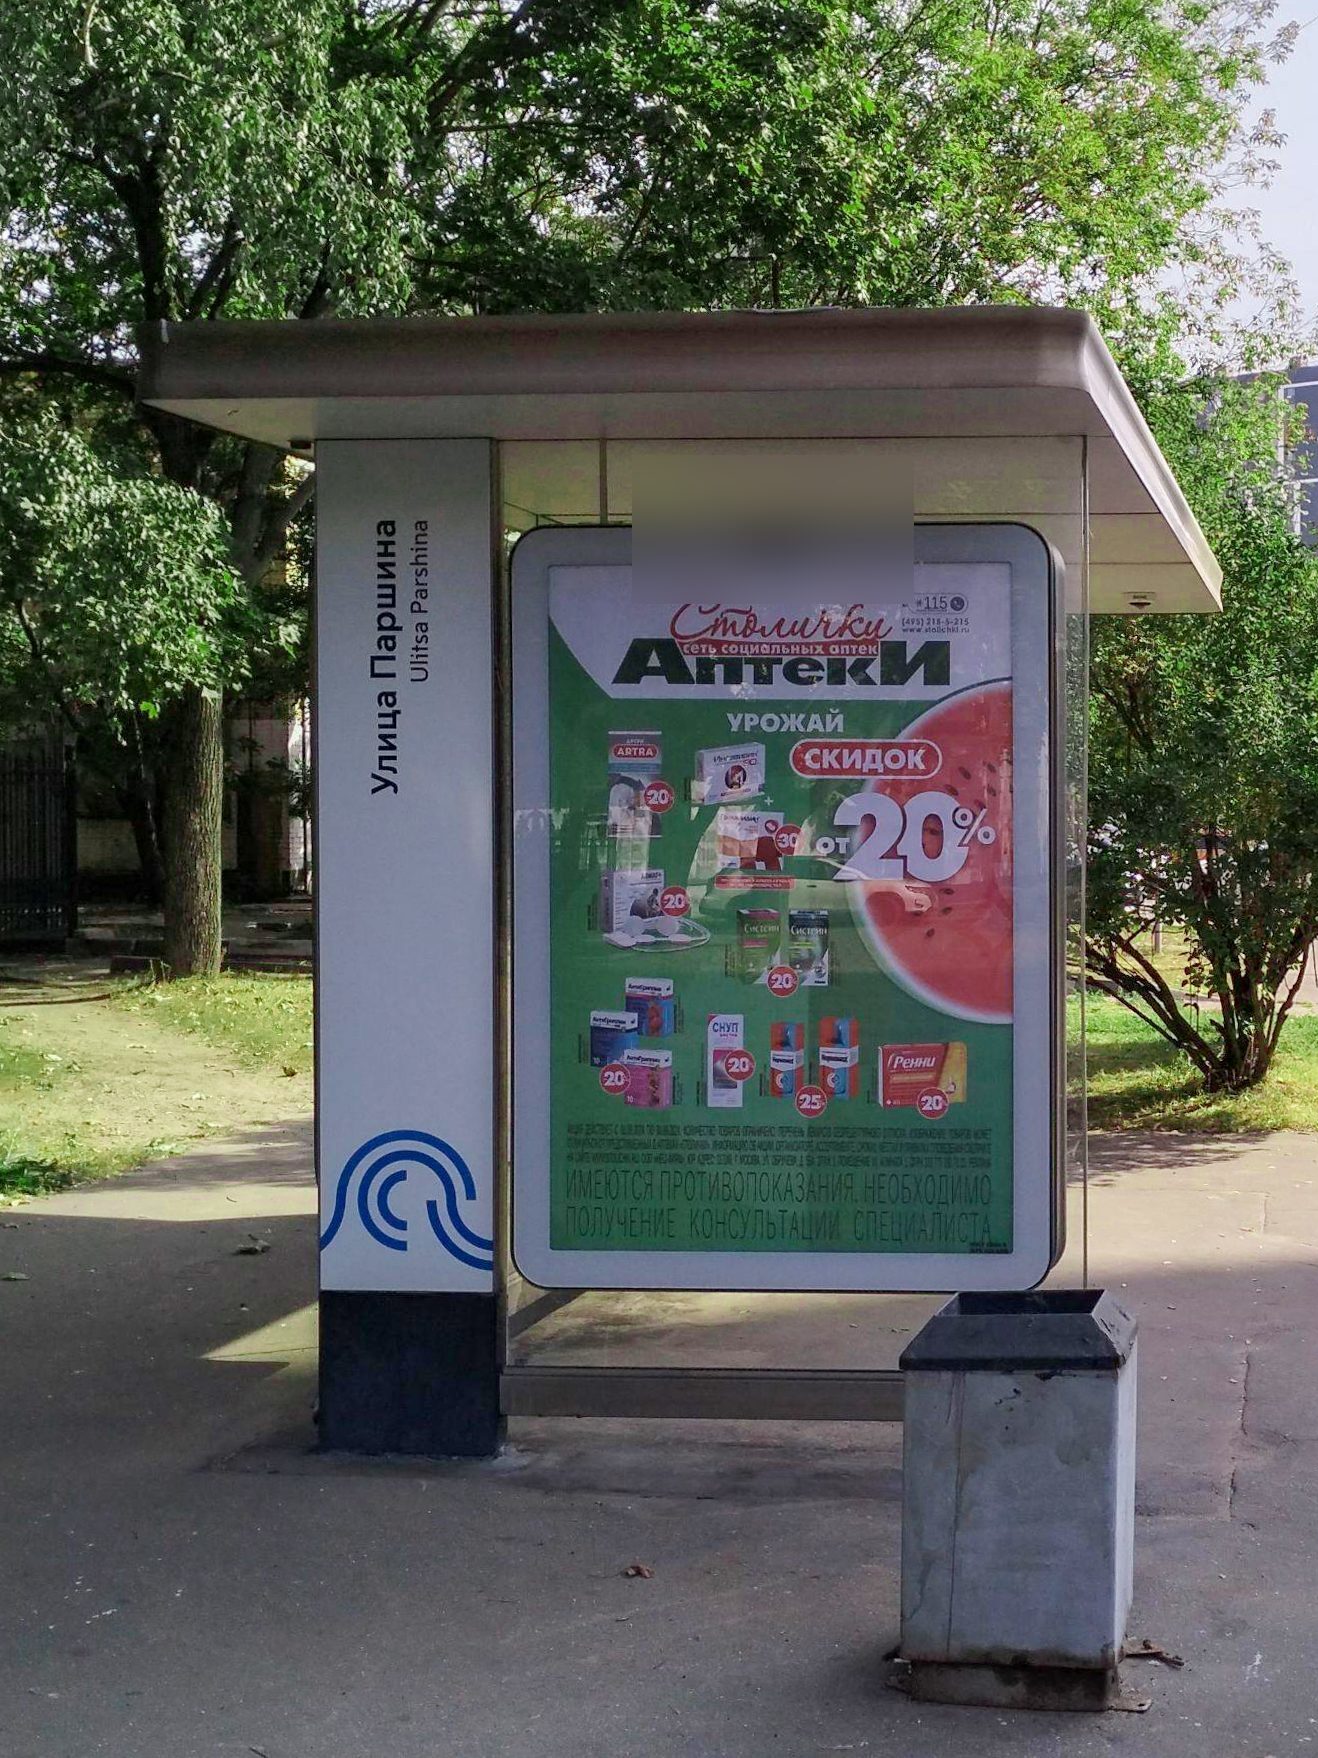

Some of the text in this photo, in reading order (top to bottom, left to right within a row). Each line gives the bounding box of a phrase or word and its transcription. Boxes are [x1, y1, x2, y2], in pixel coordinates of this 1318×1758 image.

[409, 520, 428, 682] Ulitsa Parshina
[670, 603, 893, 639] Столички
[369, 520, 403, 795] Улица Паршина
[684, 643, 879, 656] сеть социальных аптек
[727, 708, 844, 733] УРОЖАЙ
[616, 747, 654, 757] ARTRA
[804, 748, 927, 773] СКИДОК
[833, 791, 996, 882] 20%
[712, 1021, 739, 1033] СНУП
[893, 1055, 936, 1069] Ренни
[566, 1169, 653, 1201] ИМЕЮТСЯ
[864, 1173, 992, 1206] НЕОБХОДИМО
[566, 1206, 992, 1243] ПОЛУЧЕНИЕ КОНСУЛЬТАЦИИ СПЕЦИАЛИСТА
